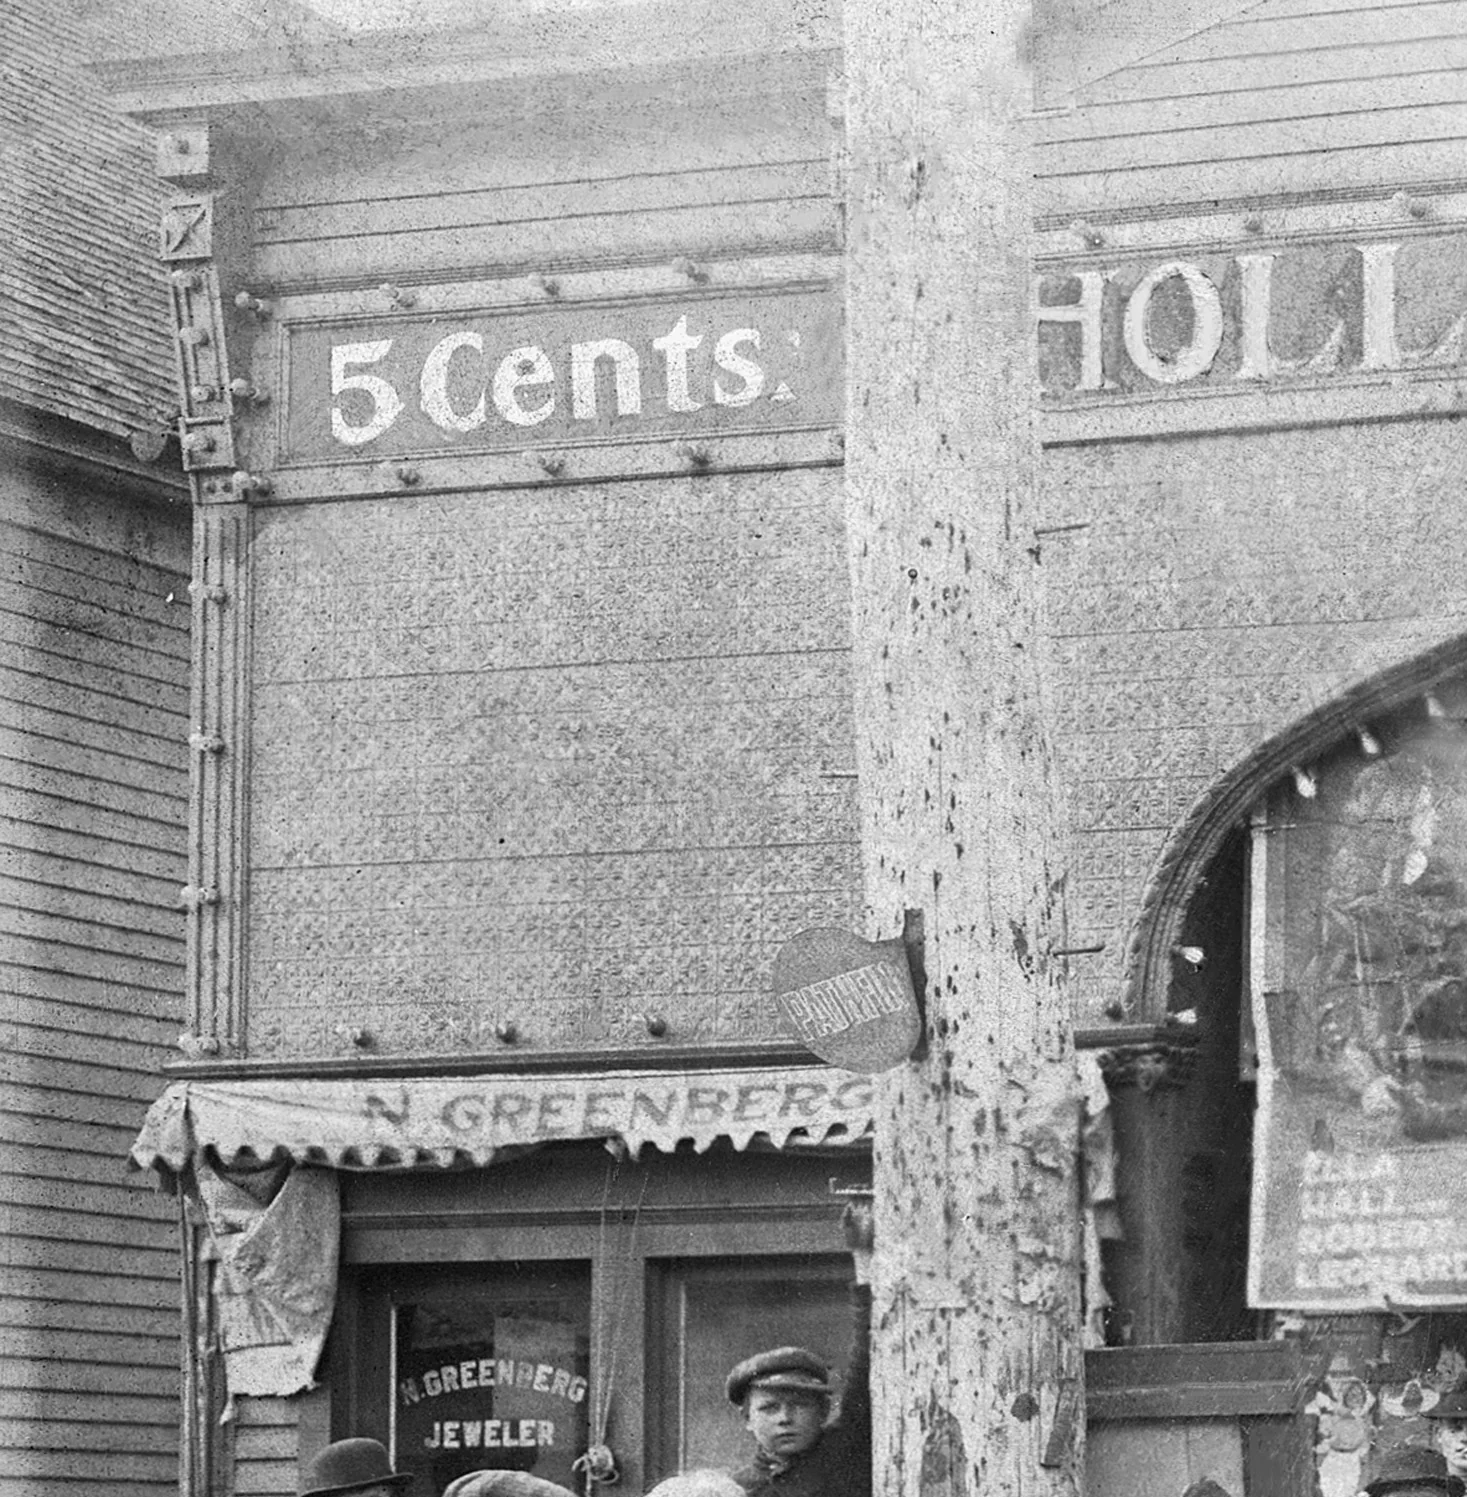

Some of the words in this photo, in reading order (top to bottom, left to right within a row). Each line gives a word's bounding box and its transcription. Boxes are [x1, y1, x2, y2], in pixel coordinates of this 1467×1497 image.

[330, 339, 405, 445] 5
[441, 1077, 874, 1135] GREENBERG
[424, 1418, 555, 1449] JEWELER
